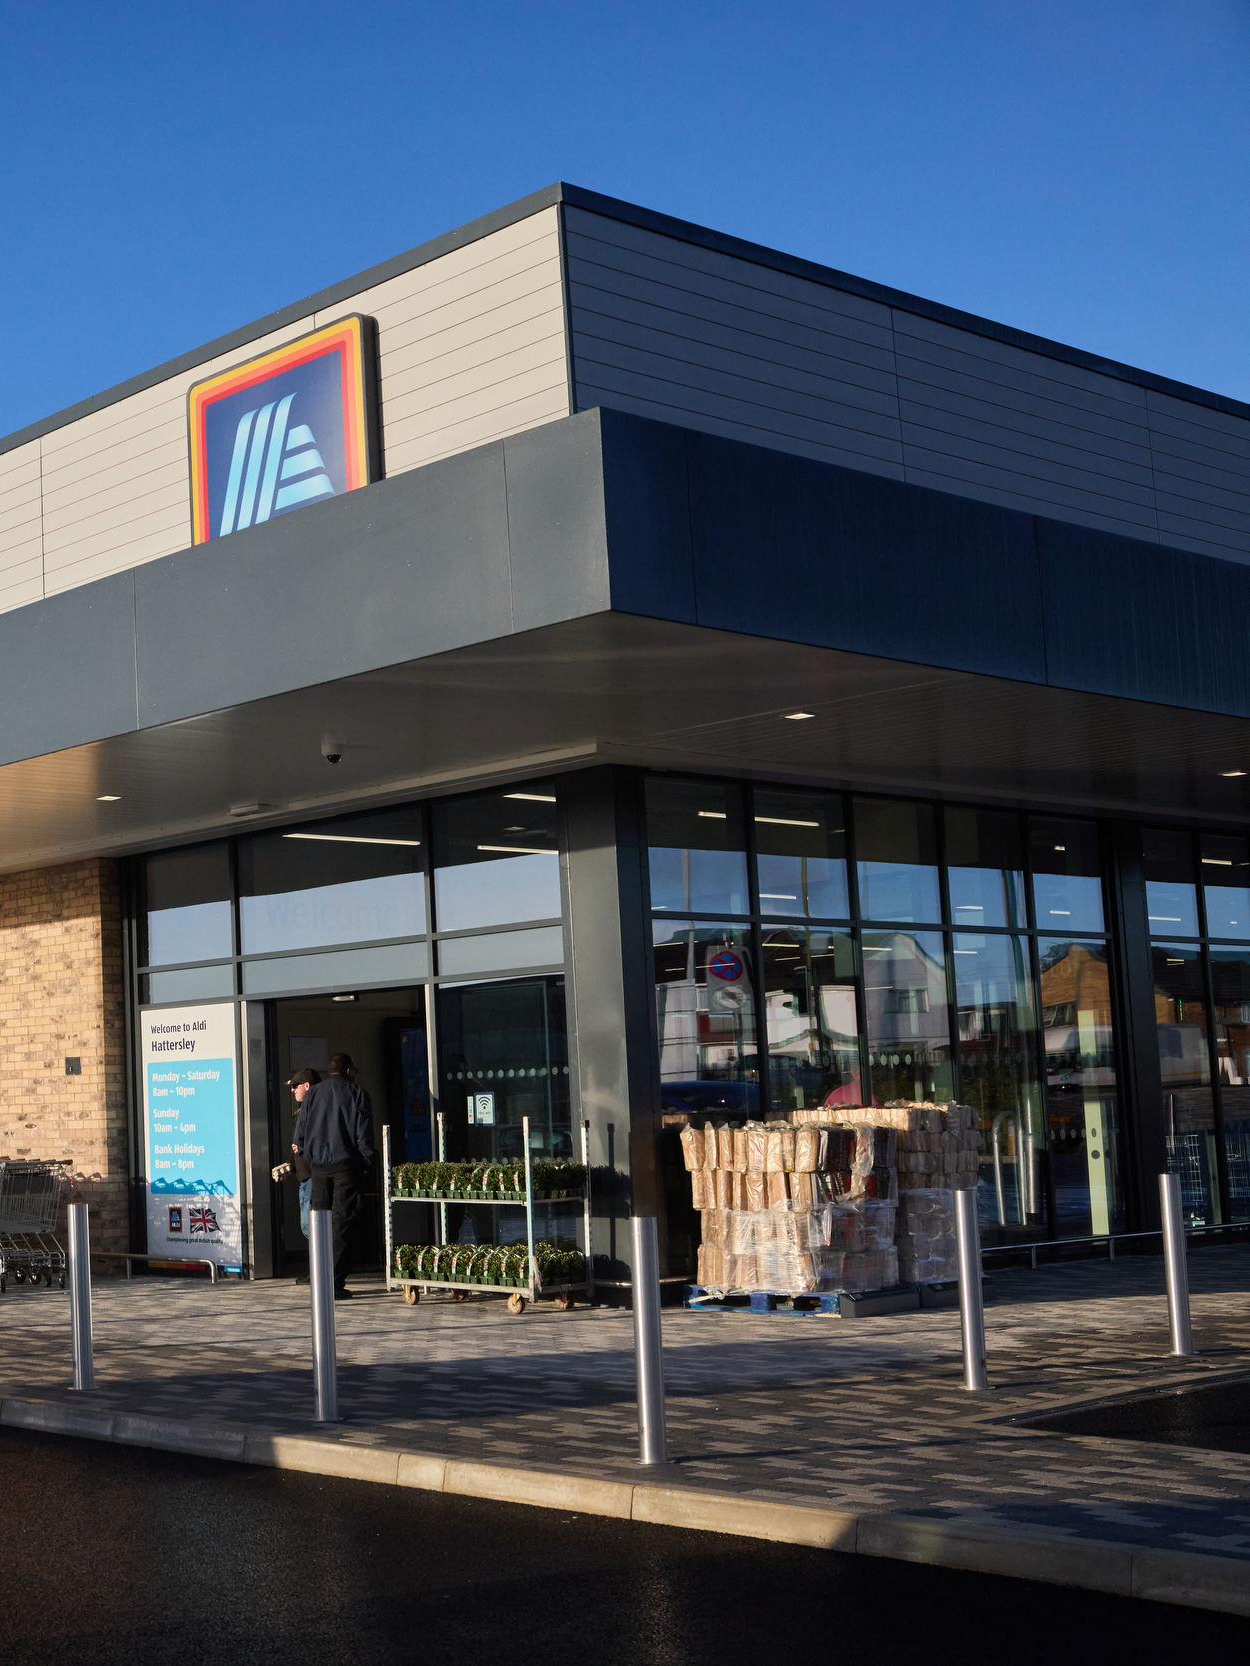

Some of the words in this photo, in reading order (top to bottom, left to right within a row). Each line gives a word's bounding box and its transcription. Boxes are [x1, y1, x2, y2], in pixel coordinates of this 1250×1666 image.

[151, 1024, 181, 1034] Welcome
[183, 1023, 190, 1032] to
[192, 1020, 207, 1031] Aldi
[152, 1038, 195, 1052] Hattersley
[152, 1072, 180, 1083] Monday
[188, 1069, 220, 1082] Saturday
[152, 1087, 168, 1097] 8am
[175, 1086, 195, 1098] 10pm
[153, 1107, 179, 1120] Sunday
[154, 1123, 172, 1133] 10am
[179, 1122, 196, 1134] 4pm
[155, 1144, 173, 1154] Bank
[174, 1143, 205, 1156] Holidays
[155, 1159, 170, 1169] 8am
[178, 1159, 194, 1171] 8pm
